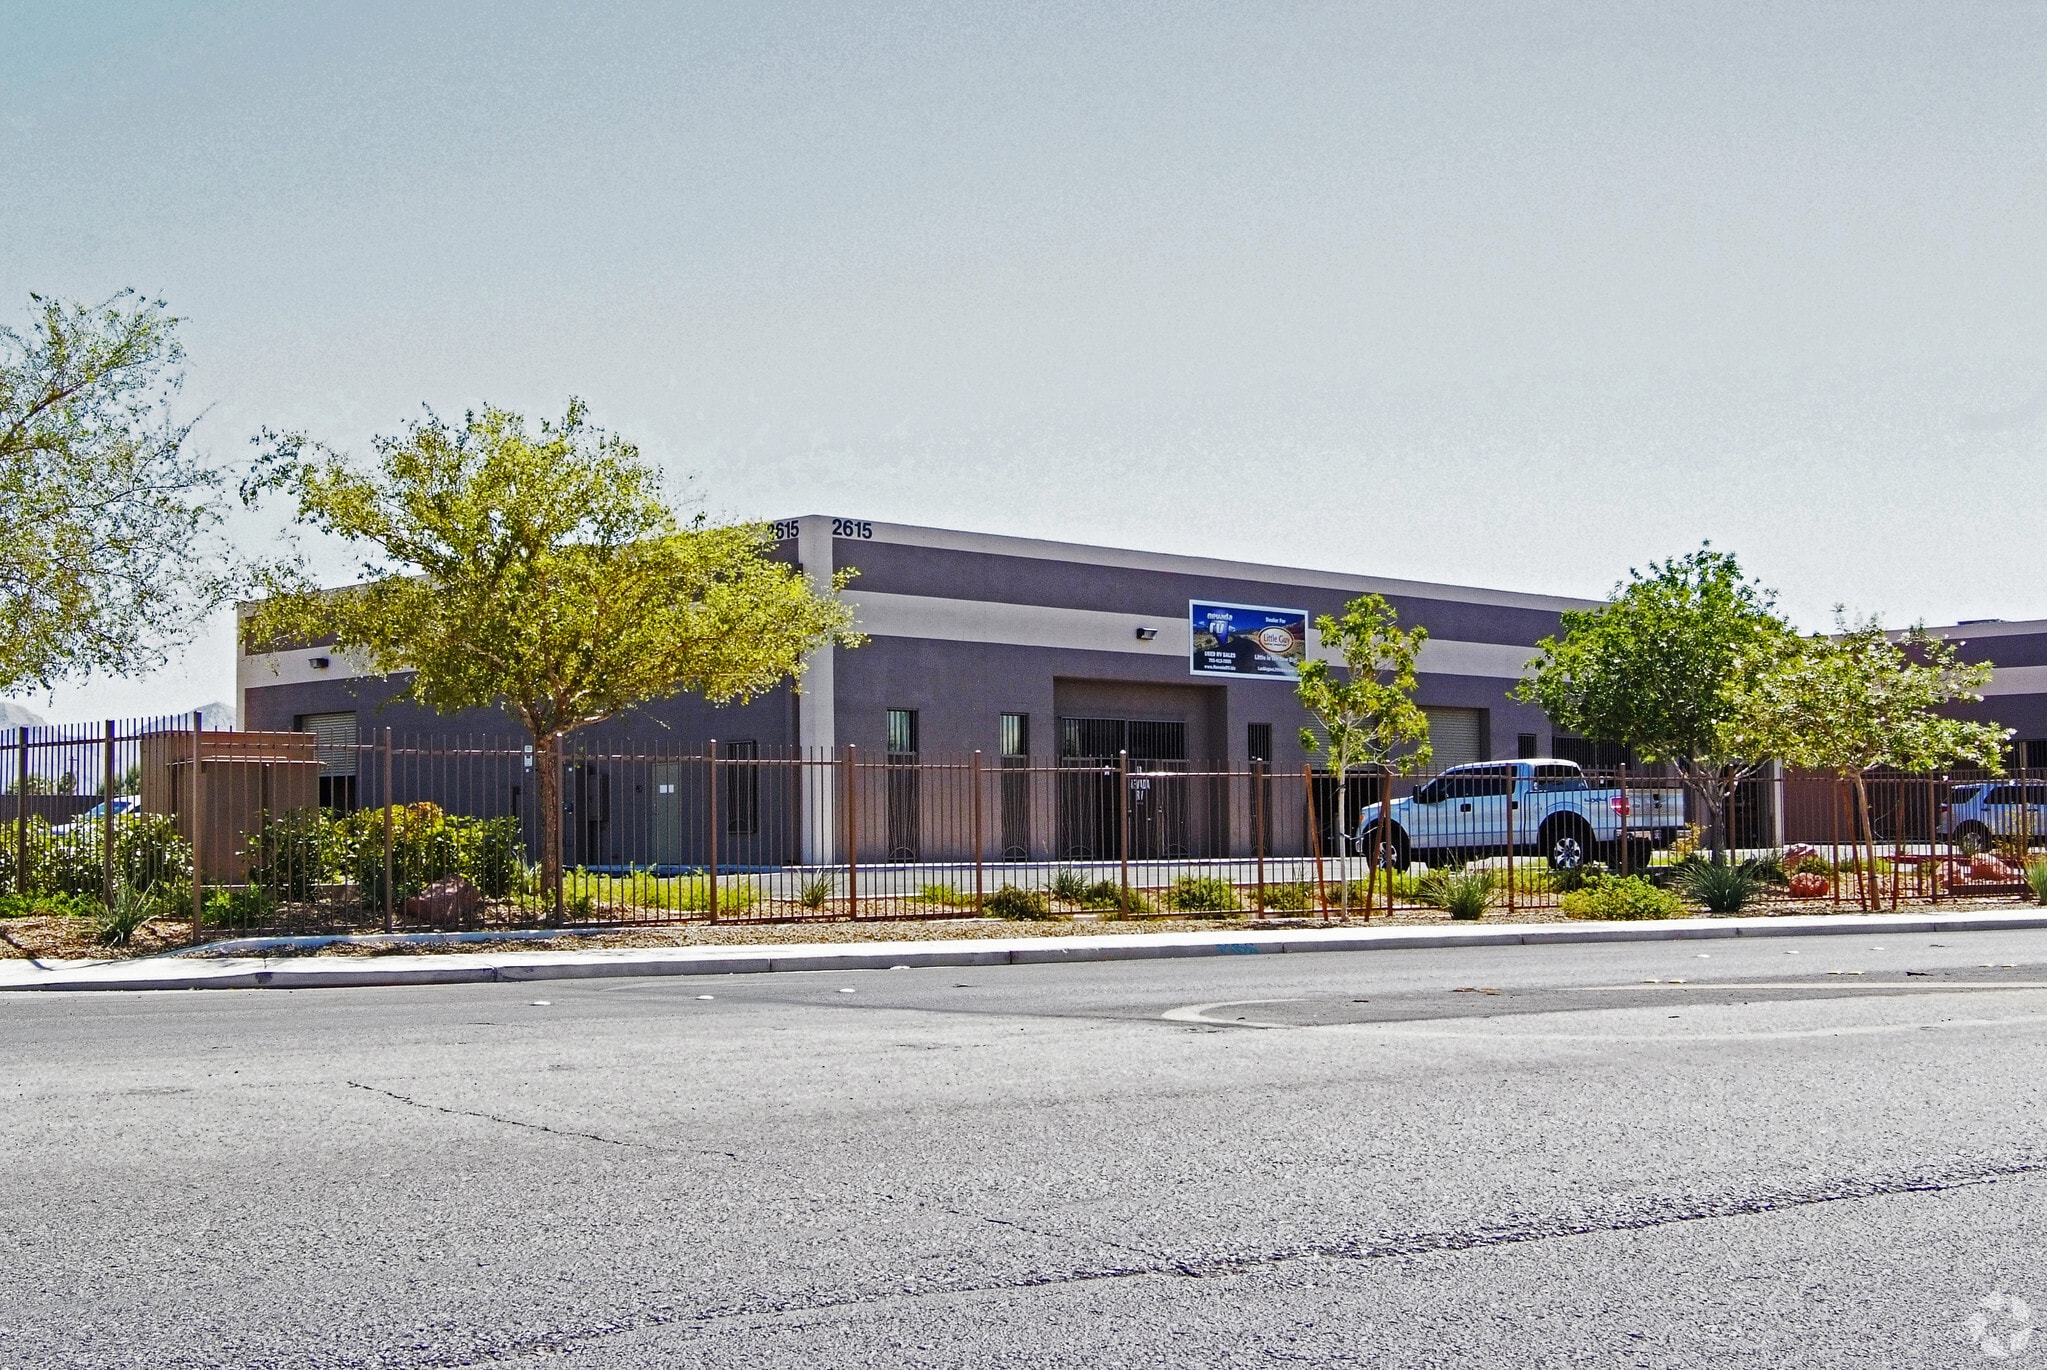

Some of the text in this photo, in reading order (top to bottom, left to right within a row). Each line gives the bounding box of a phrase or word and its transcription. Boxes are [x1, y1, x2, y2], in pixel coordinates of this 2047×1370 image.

[767, 520, 799, 539] 2615
[832, 519, 872, 539] 2615
[1263, 634, 1277, 643] Little
[1278, 635, 1290, 645] Guy
